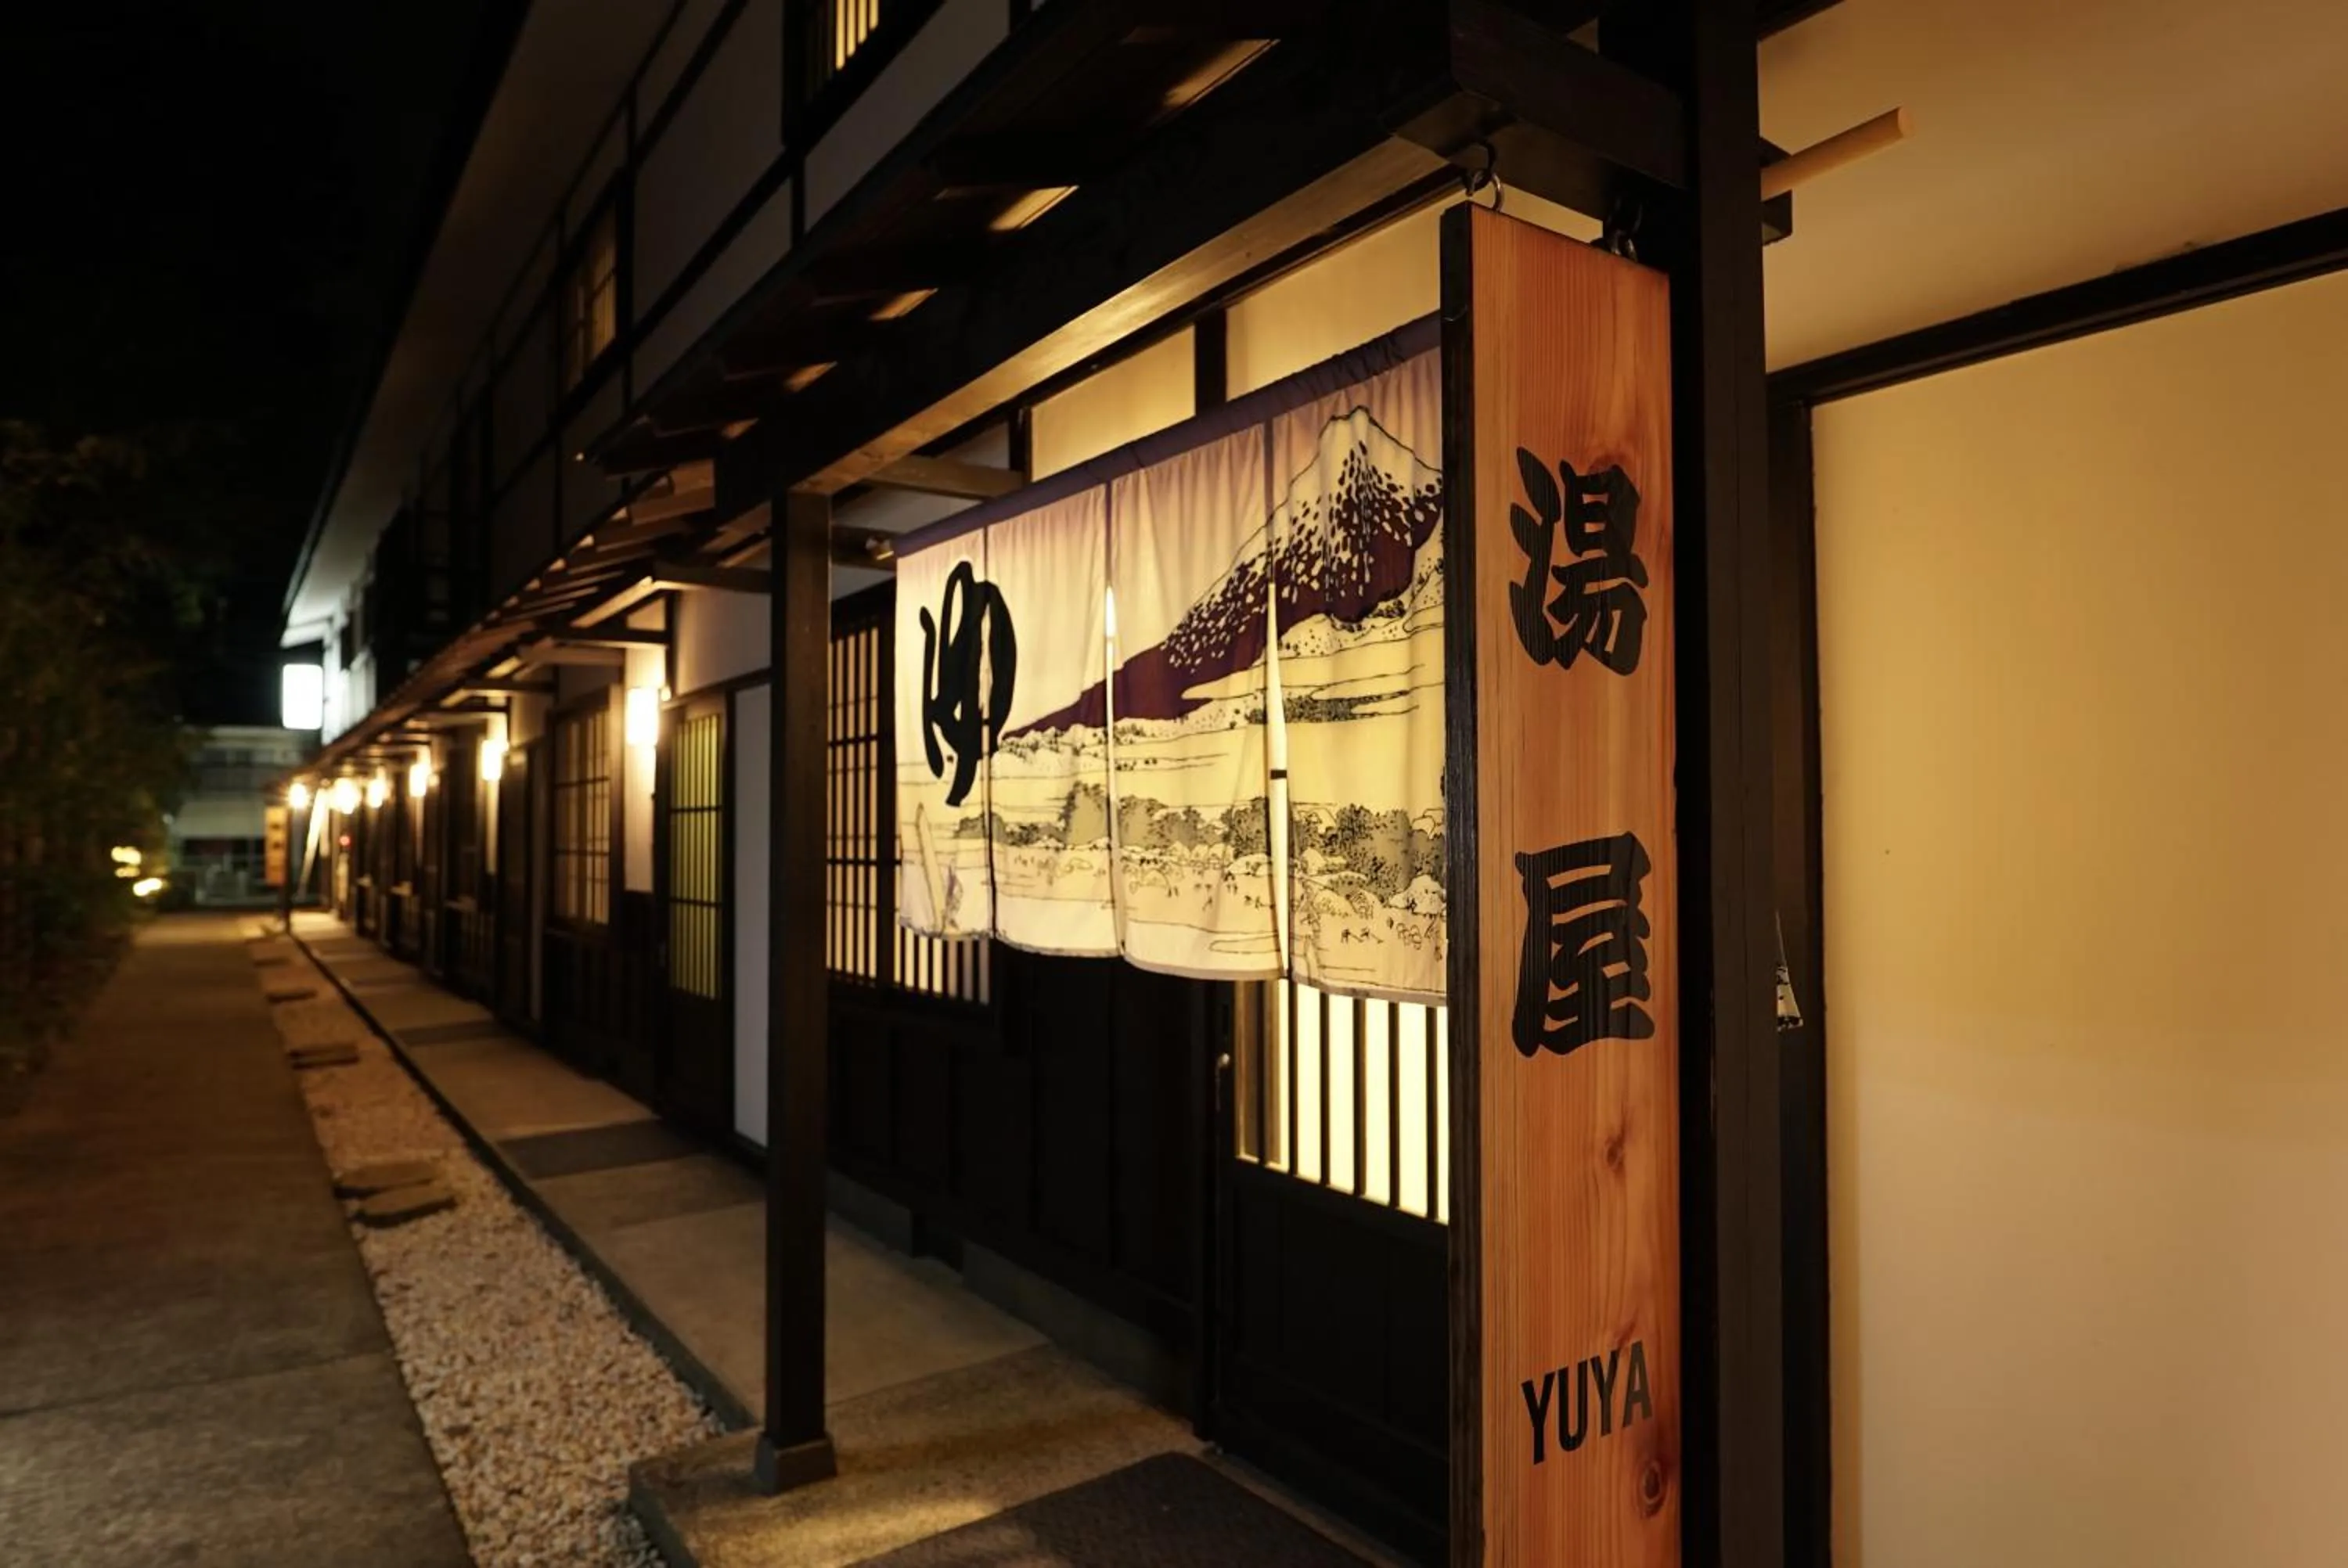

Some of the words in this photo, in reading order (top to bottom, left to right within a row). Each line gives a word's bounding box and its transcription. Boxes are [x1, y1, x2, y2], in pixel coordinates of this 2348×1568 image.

[920, 561, 1017, 807] ゆ
[1510, 447, 1655, 1058] 湯屋
[1521, 1340, 1653, 1465] YUYA
